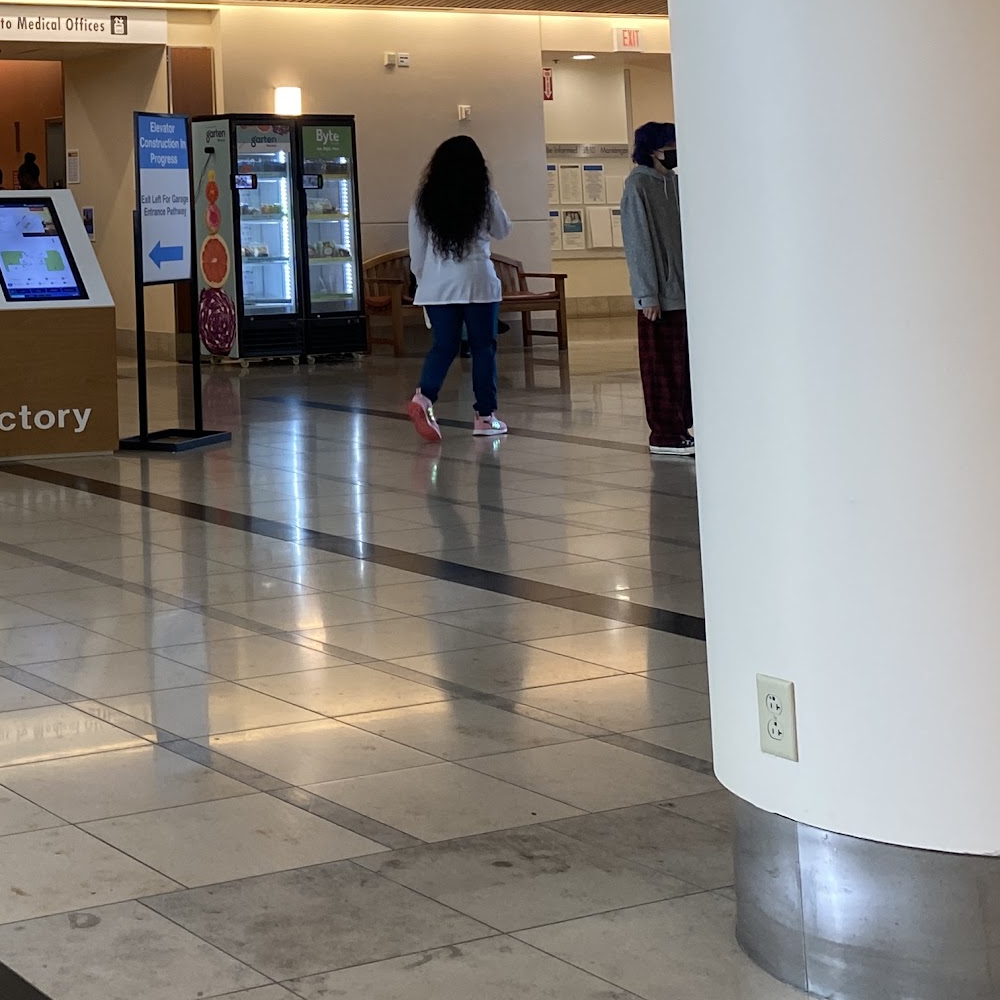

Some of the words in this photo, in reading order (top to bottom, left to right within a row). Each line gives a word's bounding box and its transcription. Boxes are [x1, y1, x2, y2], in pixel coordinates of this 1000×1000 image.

[0, 17, 12, 29] to
[17, 16, 61, 31] Medical
[65, 18, 105, 32] Offices
[622, 30, 640, 47] EXIT
[150, 121, 175, 133] Elevator
[140, 136, 179, 149] Construction
[206, 129, 226, 143] garten
[251, 135, 277, 147] garten
[316, 128, 340, 145] Byte
[150, 152, 178, 167] Progress
[141, 194, 151, 204] Exit
[152, 194, 162, 204] Left
[172, 194, 189, 205] Garage
[144, 207, 166, 216] Entrance
